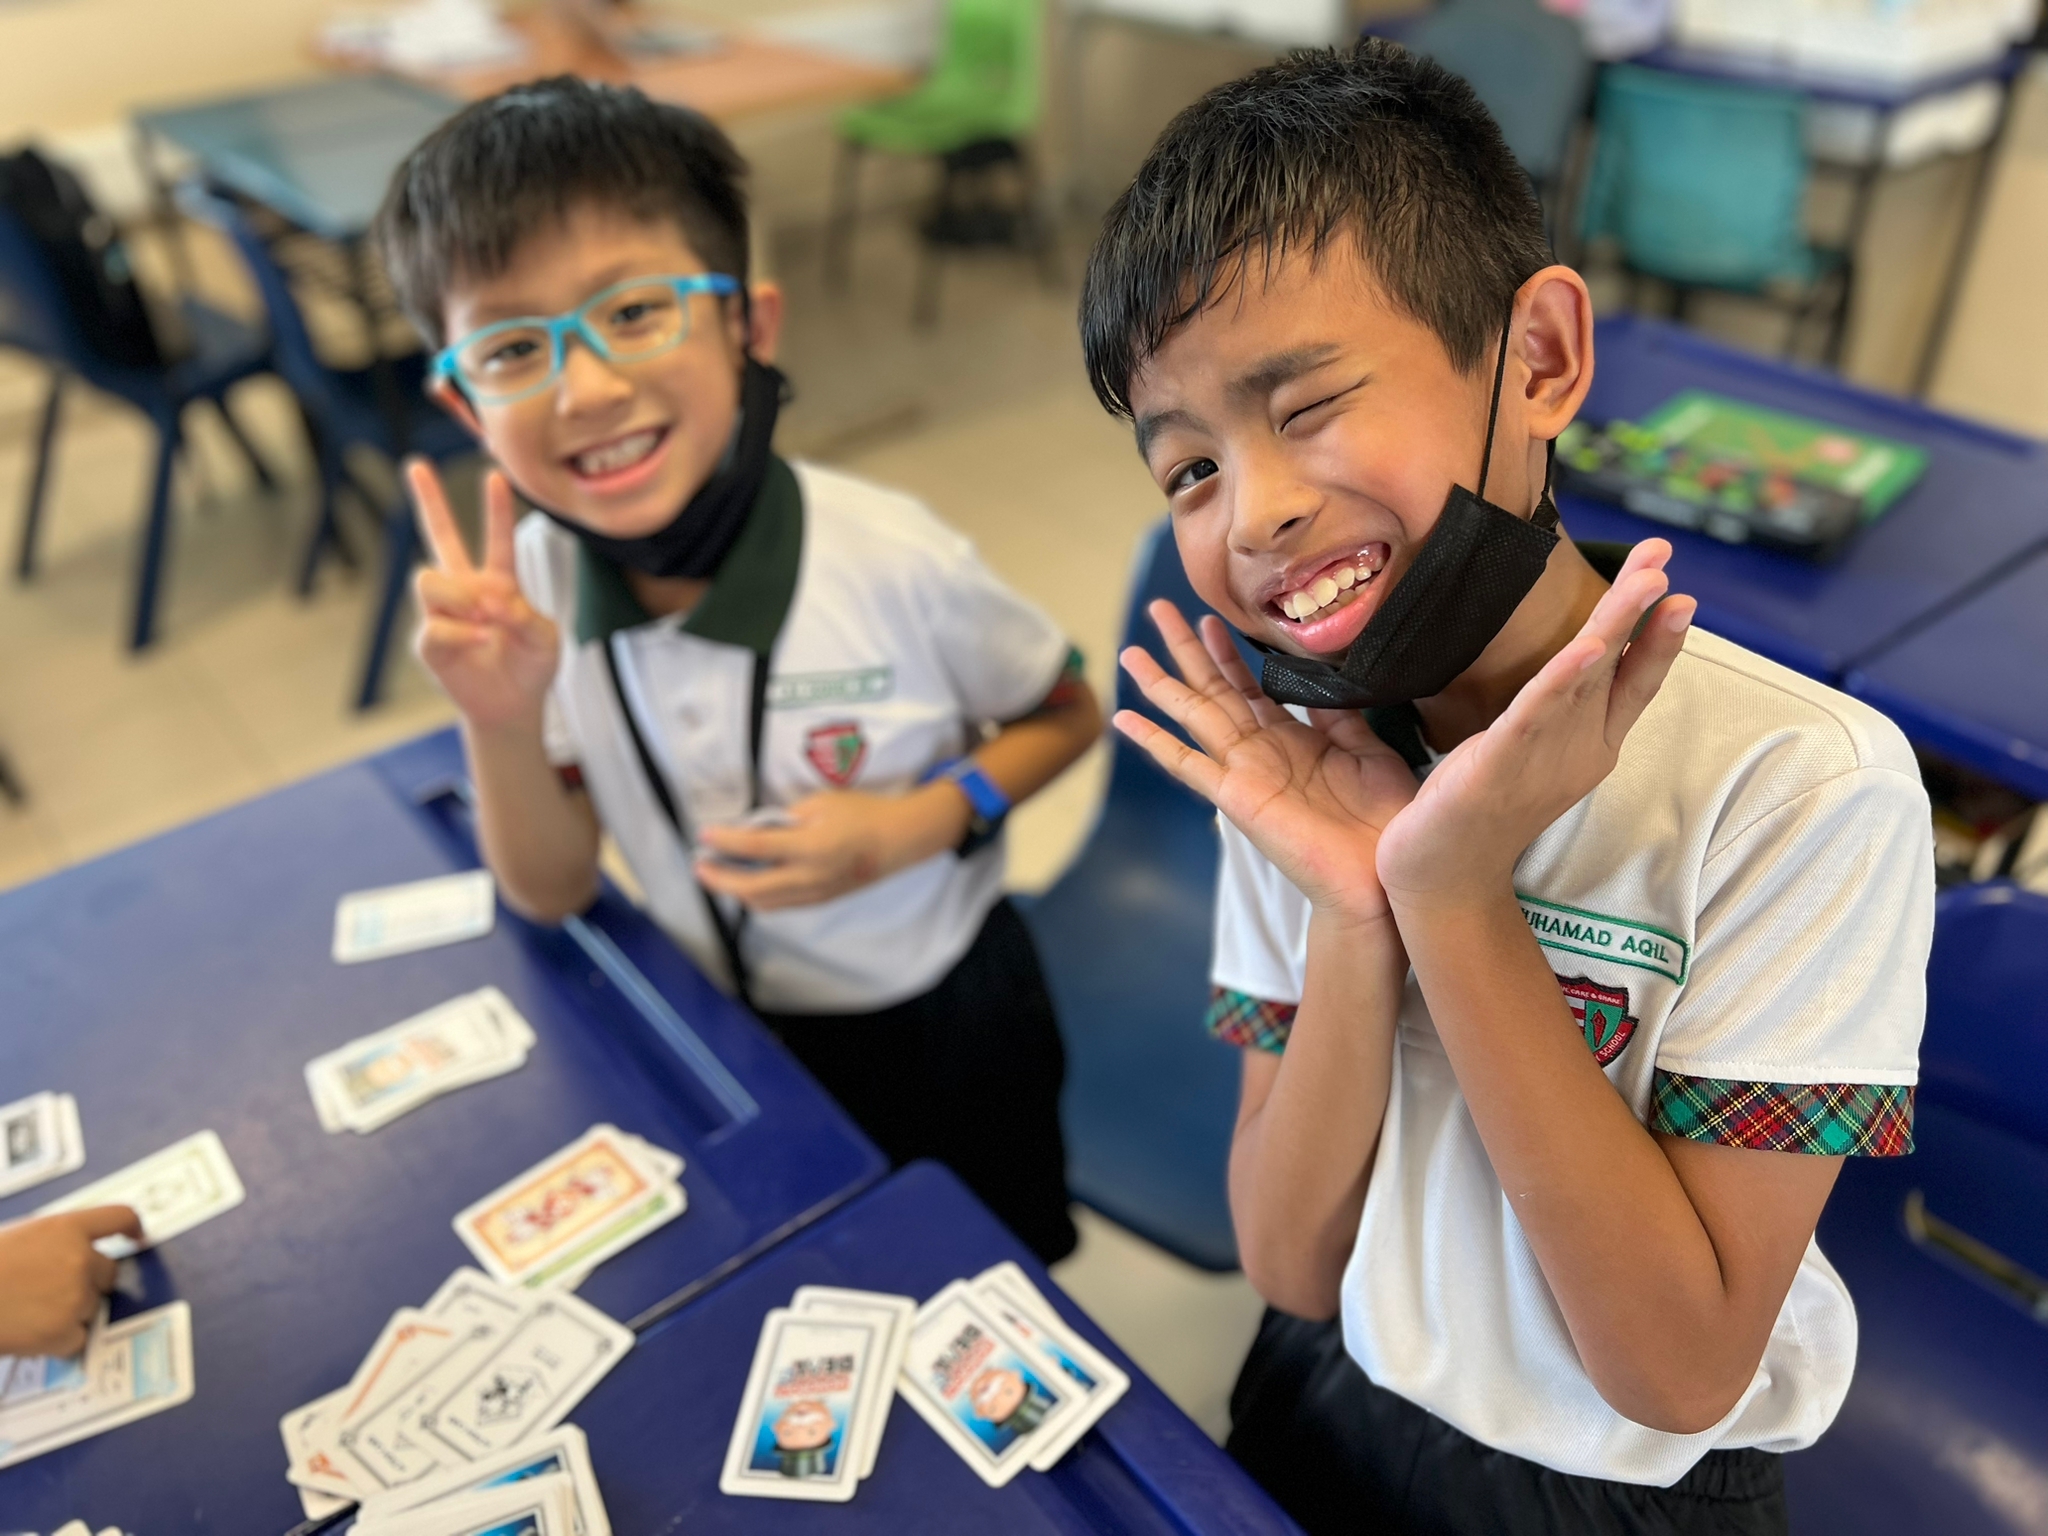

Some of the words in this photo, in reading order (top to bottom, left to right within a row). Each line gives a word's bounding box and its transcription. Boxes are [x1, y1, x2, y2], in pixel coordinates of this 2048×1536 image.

[1521, 907, 1612, 946] UHAMAD
[1620, 935, 1669, 963] AQIL
[1599, 1031, 1626, 1057] SCHOOL
